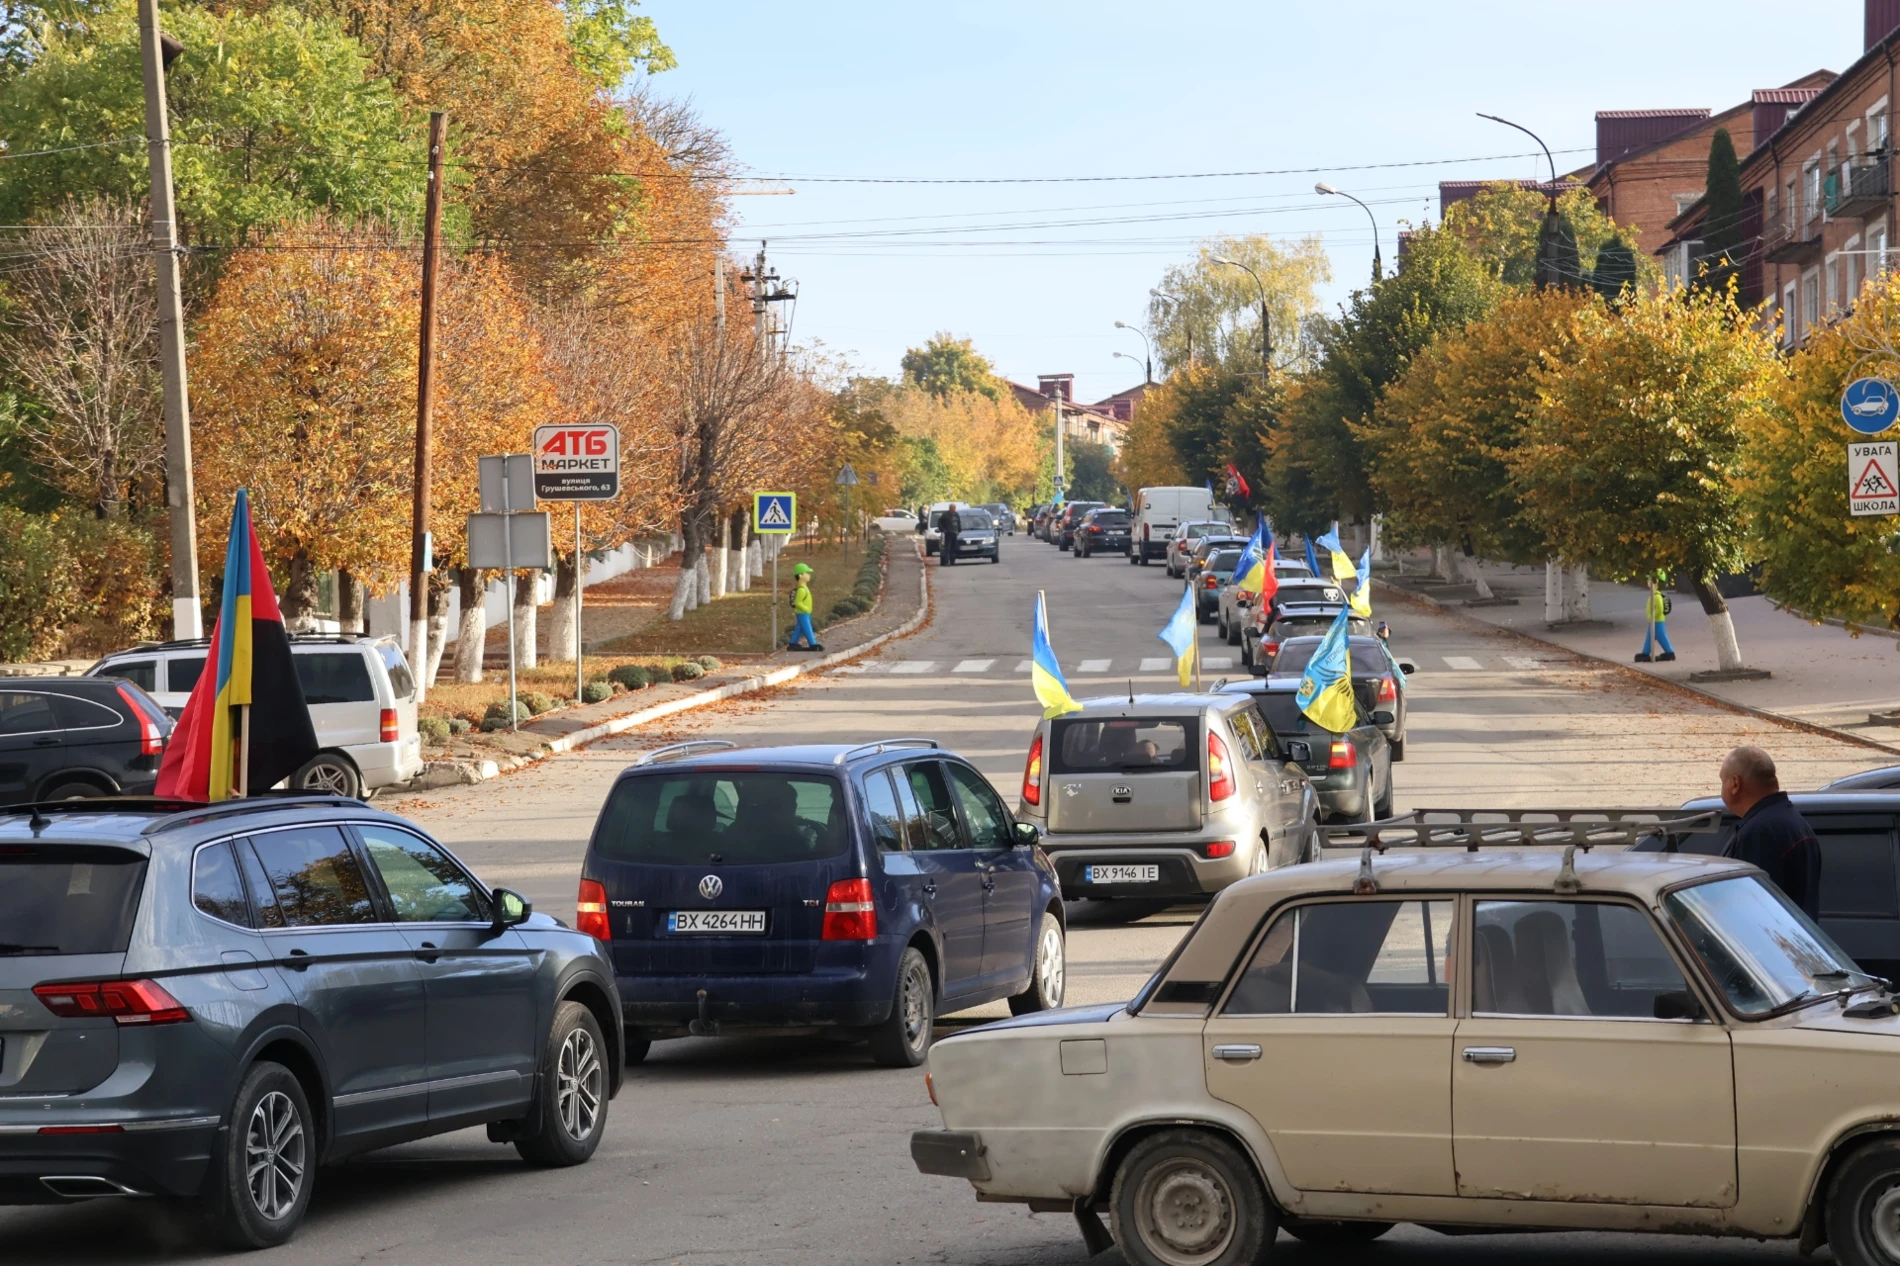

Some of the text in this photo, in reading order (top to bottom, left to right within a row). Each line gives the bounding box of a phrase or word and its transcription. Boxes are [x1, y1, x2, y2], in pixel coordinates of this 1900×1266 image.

[542, 430, 609, 456] АТБ
[1854, 446, 1892, 457] УВАГА
[541, 458, 611, 471] МАРКЕТ
[561, 478, 591, 486] вулиця
[541, 485, 600, 493] Грушевського,
[1853, 500, 1896, 512] ШКОЛА
[1093, 867, 1156, 879] BX 9146 IE
[676, 914, 764, 929] BX 4264 HH
